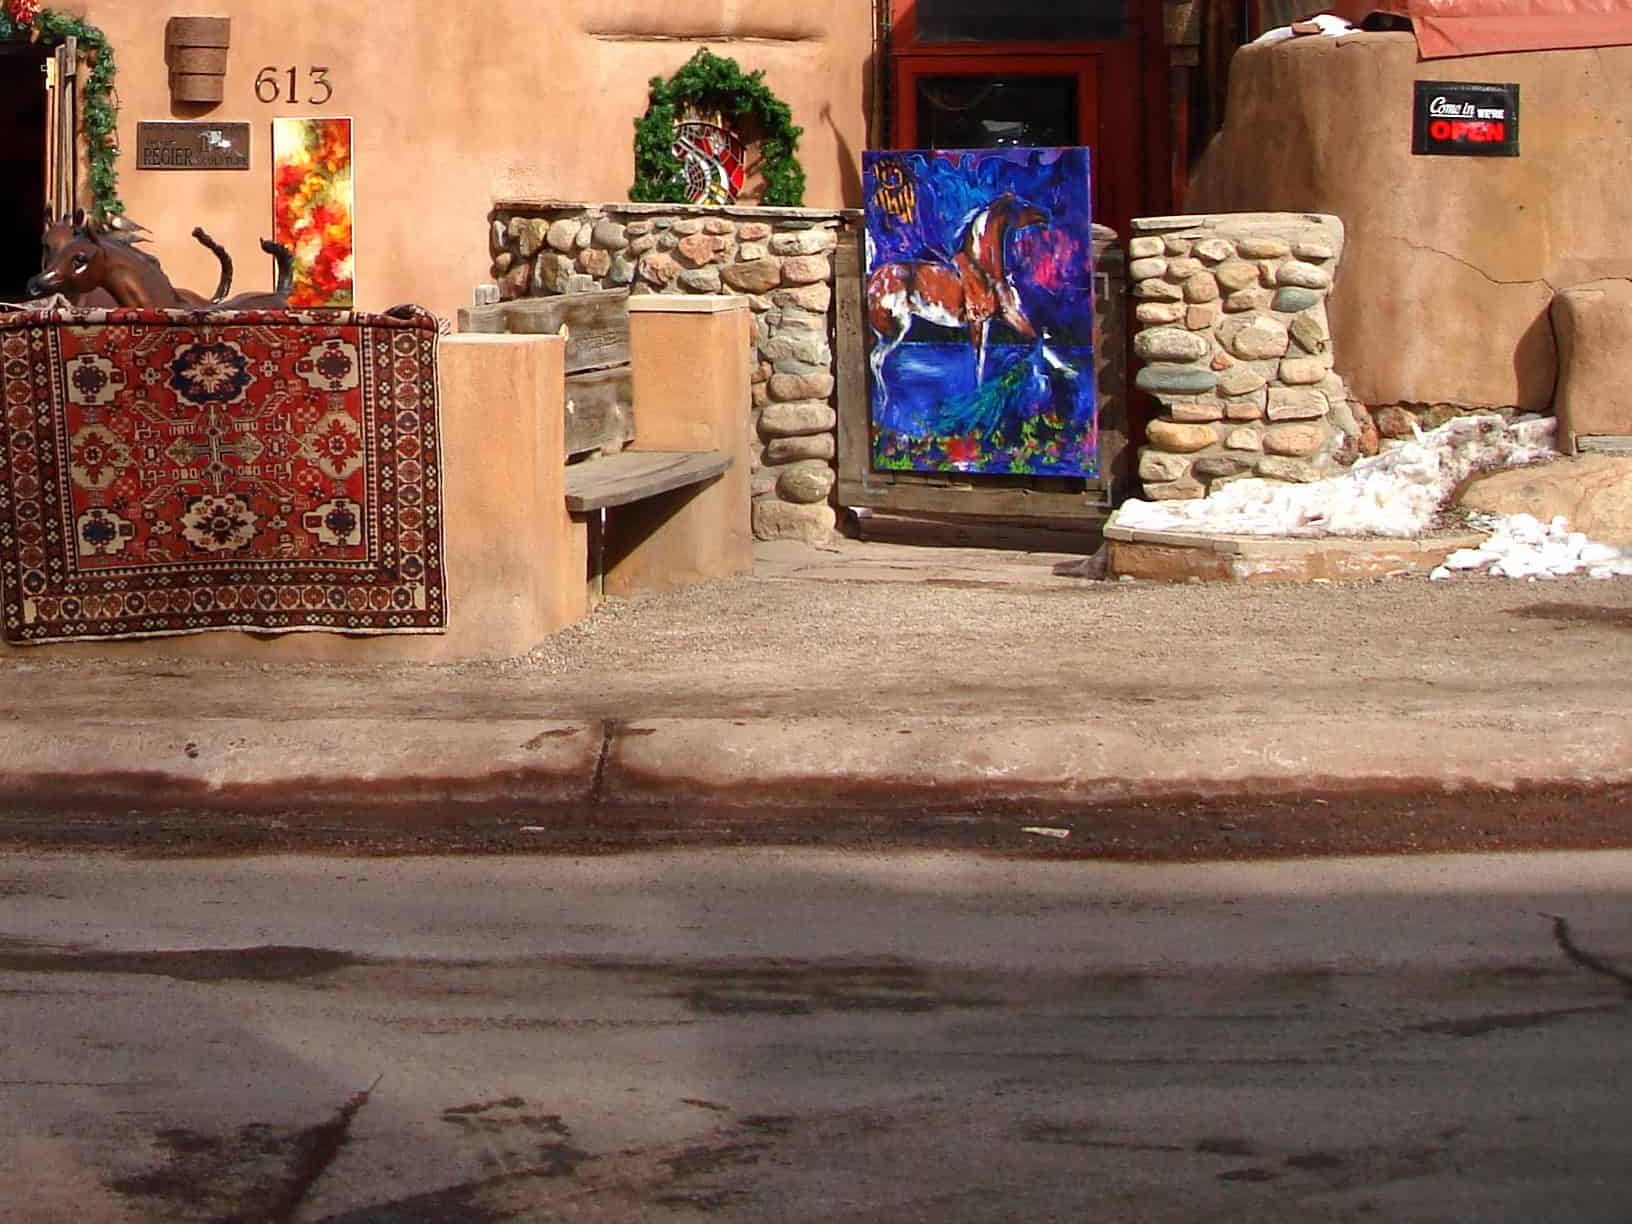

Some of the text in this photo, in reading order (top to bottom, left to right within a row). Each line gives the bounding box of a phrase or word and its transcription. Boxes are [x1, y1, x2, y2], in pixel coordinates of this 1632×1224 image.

[254, 66, 333, 105] 613
[1430, 96, 1462, 115] Come
[1463, 102, 1475, 115] in
[1430, 120, 1505, 142] OPEN
